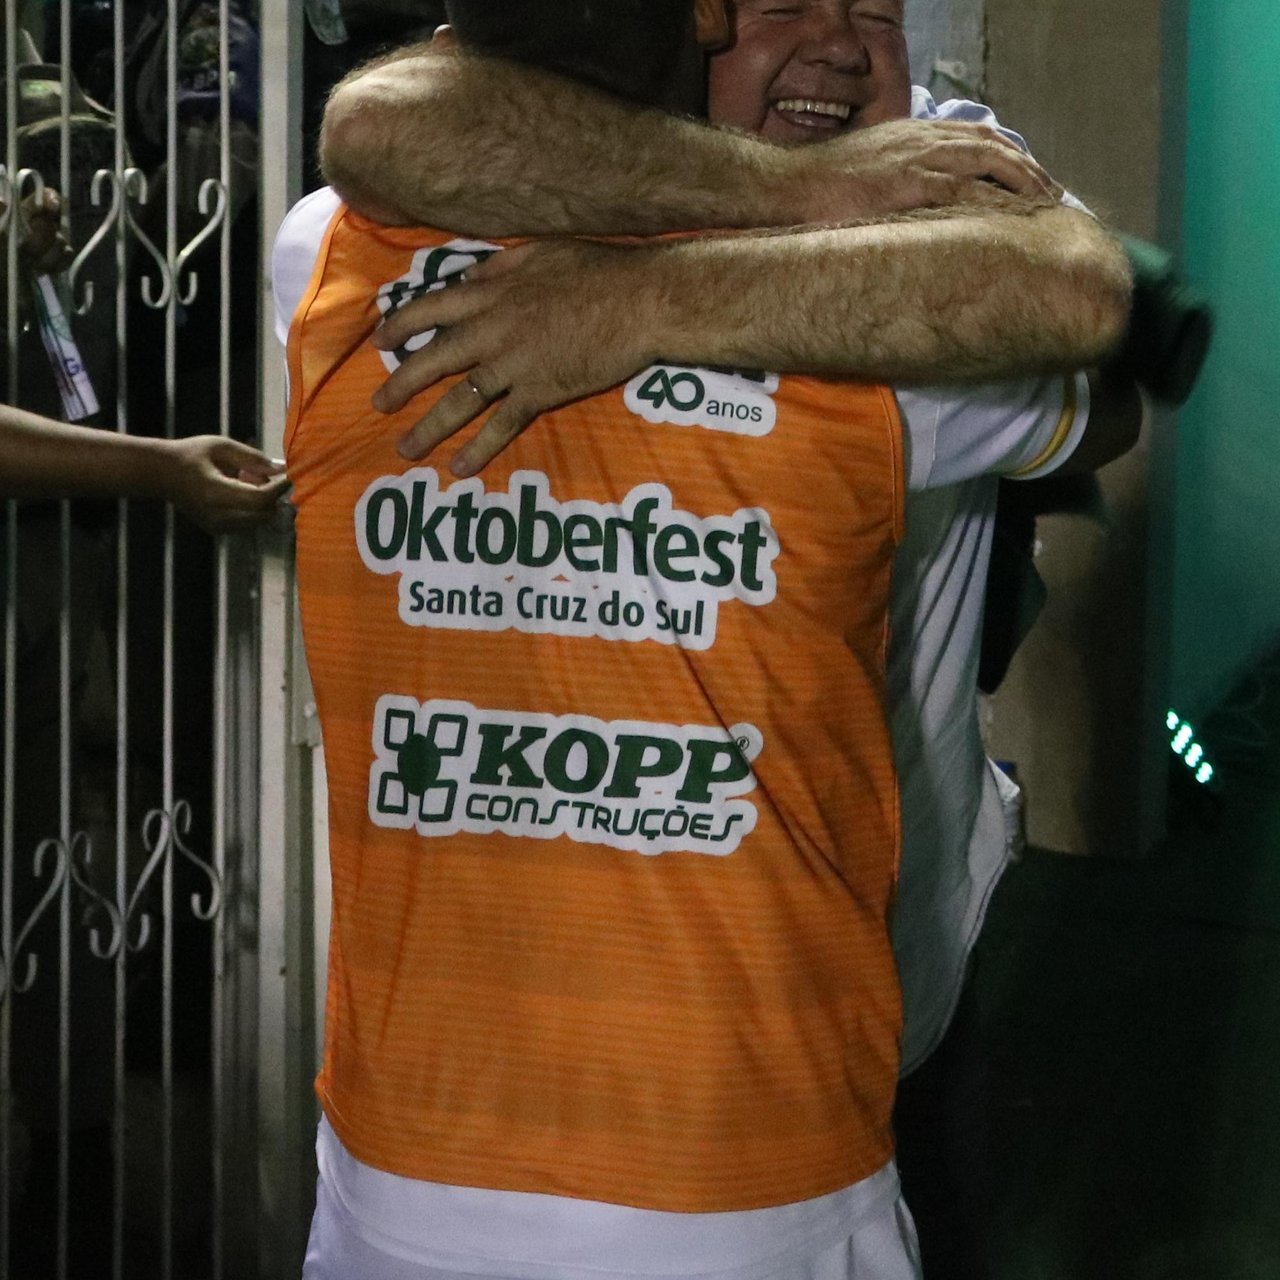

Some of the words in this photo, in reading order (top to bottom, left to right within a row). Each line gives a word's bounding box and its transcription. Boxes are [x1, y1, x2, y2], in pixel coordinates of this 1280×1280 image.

[636, 368, 706, 412] 40
[706, 400, 763, 423] anos
[365, 481, 768, 592] Oktoberfest
[409, 580, 504, 617] Santa
[516, 586, 588, 623] Cruz
[598, 590, 645, 628] do
[655, 599, 705, 636] Sul
[469, 723, 751, 803] KOPP
